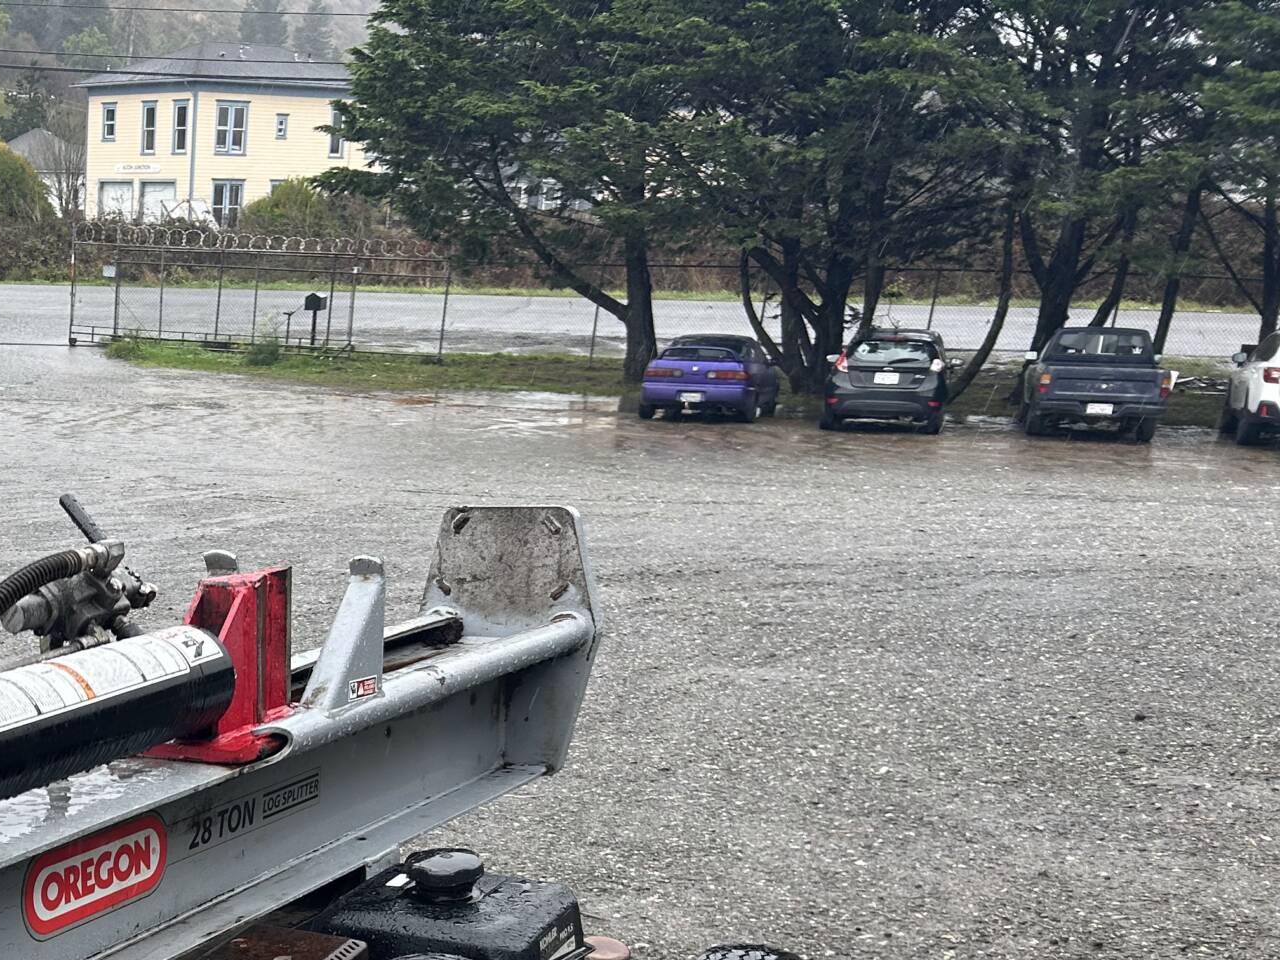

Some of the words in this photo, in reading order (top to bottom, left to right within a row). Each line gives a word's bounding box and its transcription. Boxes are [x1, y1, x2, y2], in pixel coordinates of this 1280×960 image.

[262, 796, 281, 813] LOG
[281, 778, 319, 804] SPLITTER
[188, 815, 213, 850] 28
[217, 797, 256, 838] TON
[40, 835, 151, 912] OREGON
